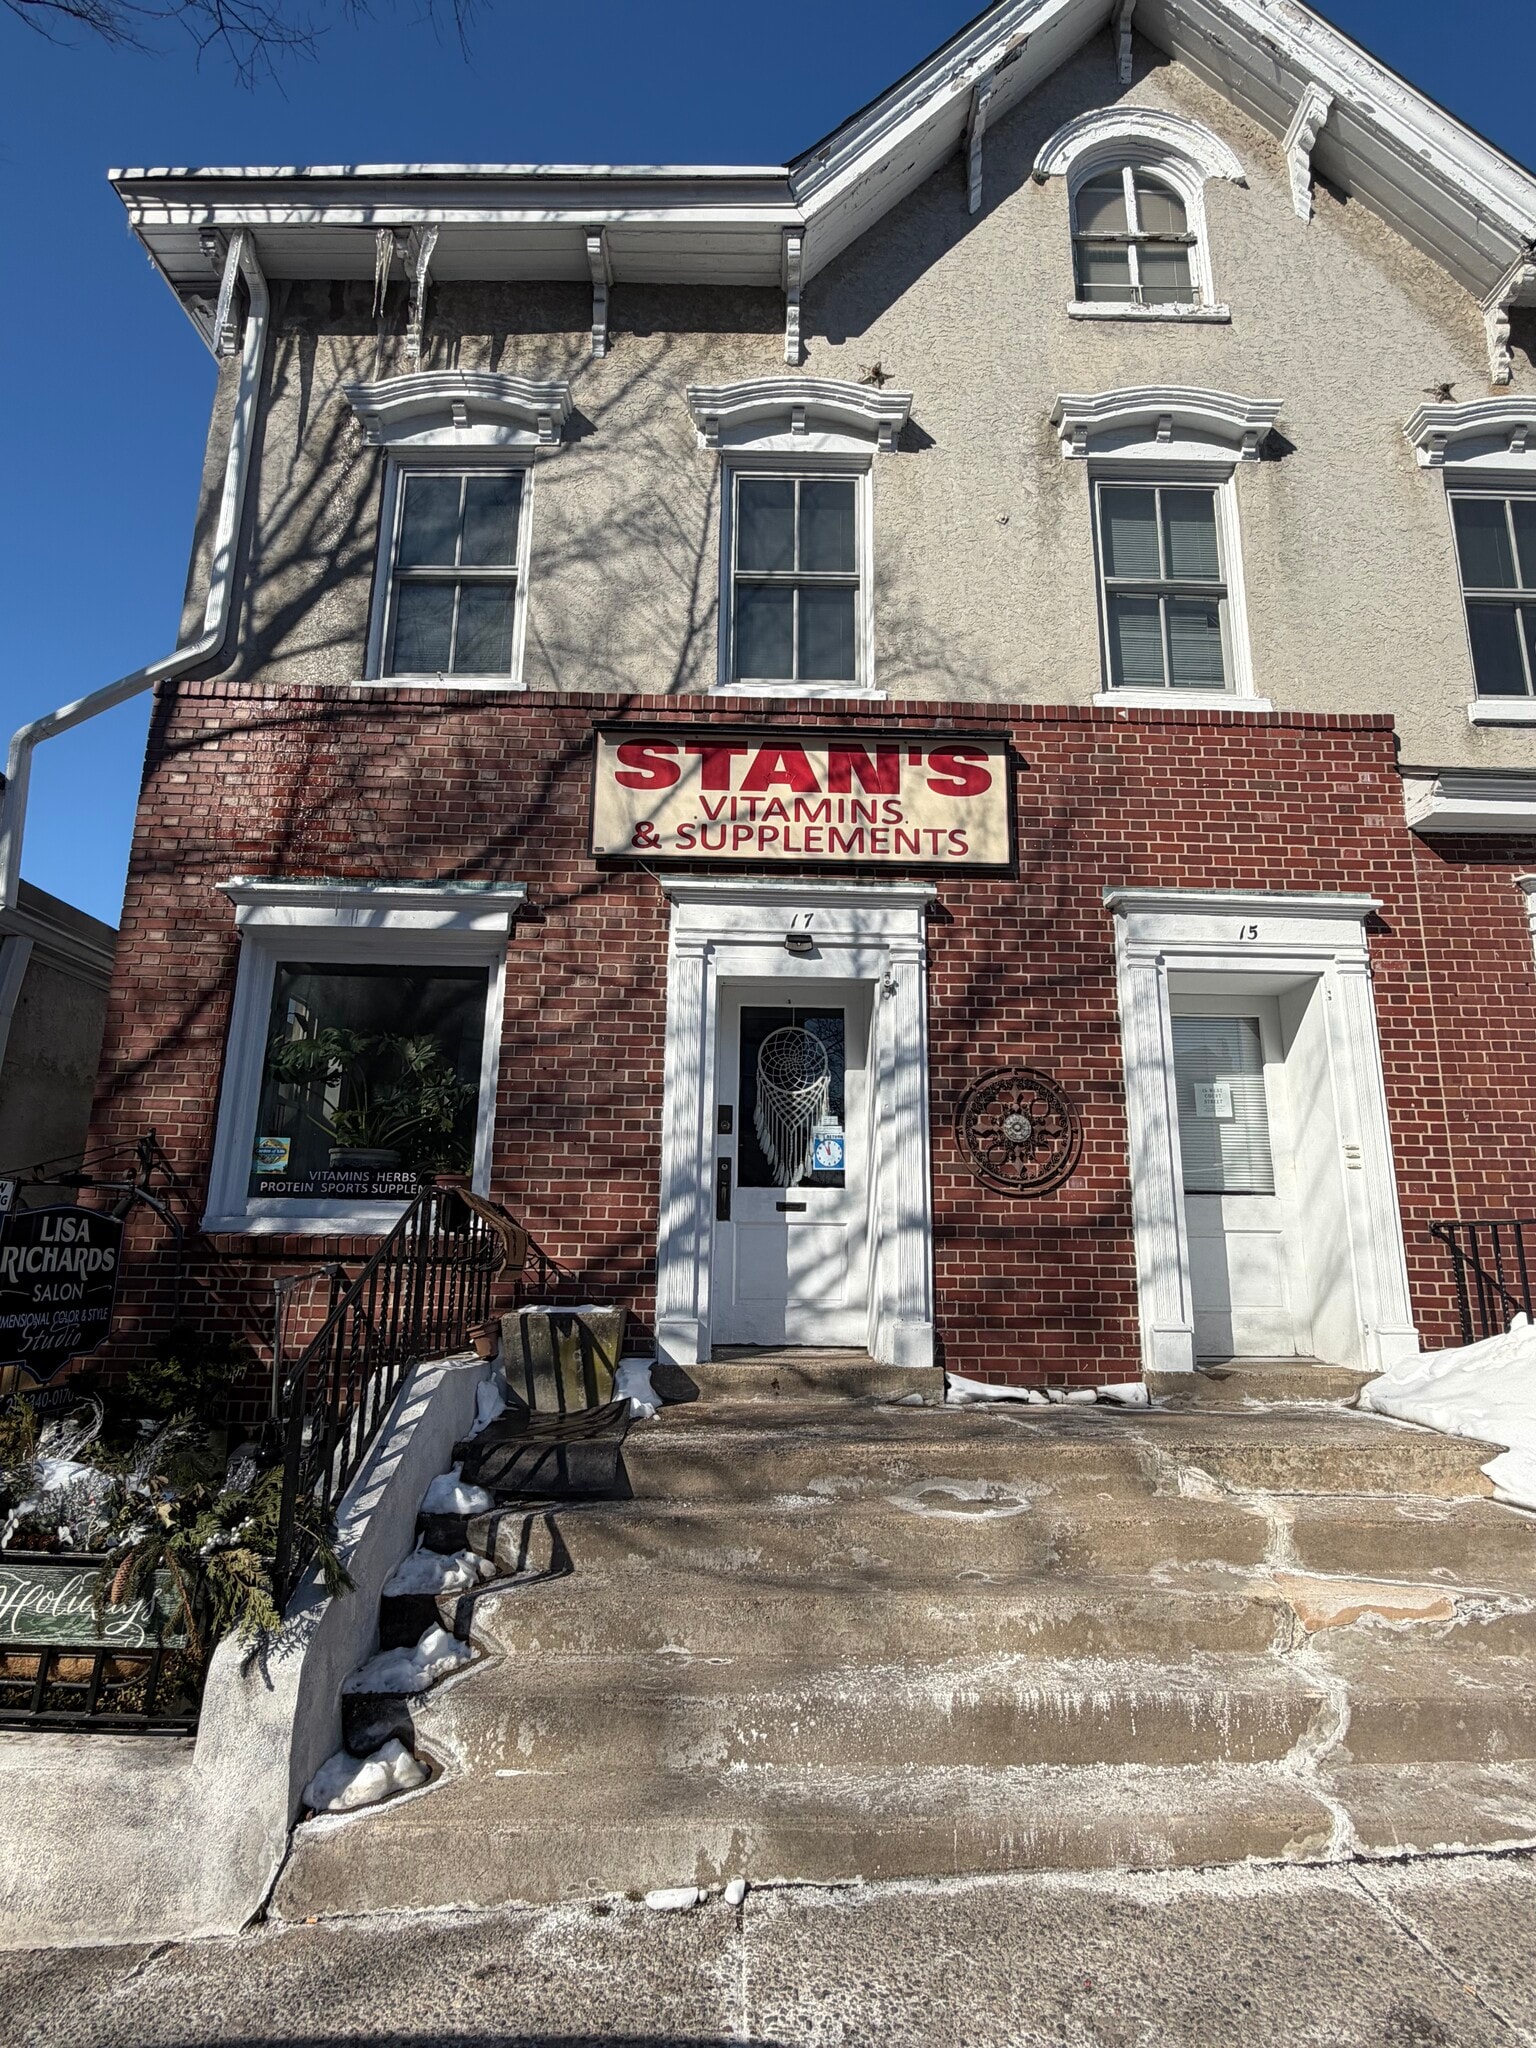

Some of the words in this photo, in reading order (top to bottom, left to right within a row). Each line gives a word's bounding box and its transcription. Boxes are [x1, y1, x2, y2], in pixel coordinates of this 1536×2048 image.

[614, 738, 993, 797] STAN'S
[699, 795, 904, 825] VITAMINS
[631, 821, 662, 850] &
[675, 822, 969, 857] SUPPLEMENTS
[790, 912, 815, 929] 17
[1239, 924, 1258, 940] 15
[260, 1181, 314, 1192] PROTEIN
[320, 1182, 368, 1193] SPORTS
[309, 1170, 370, 1182] VITAMINS
[377, 1172, 417, 1182] HERBS
[40, 1216, 90, 1242] LISA
[0, 1246, 115, 1284] RICHARDS
[32, 1283, 84, 1302] SALON
[53, 1310, 80, 1324] COLOR
[81, 1309, 87, 1321] &
[88, 1307, 108, 1321] STYLE
[17, 1323, 81, 1352] Studio
